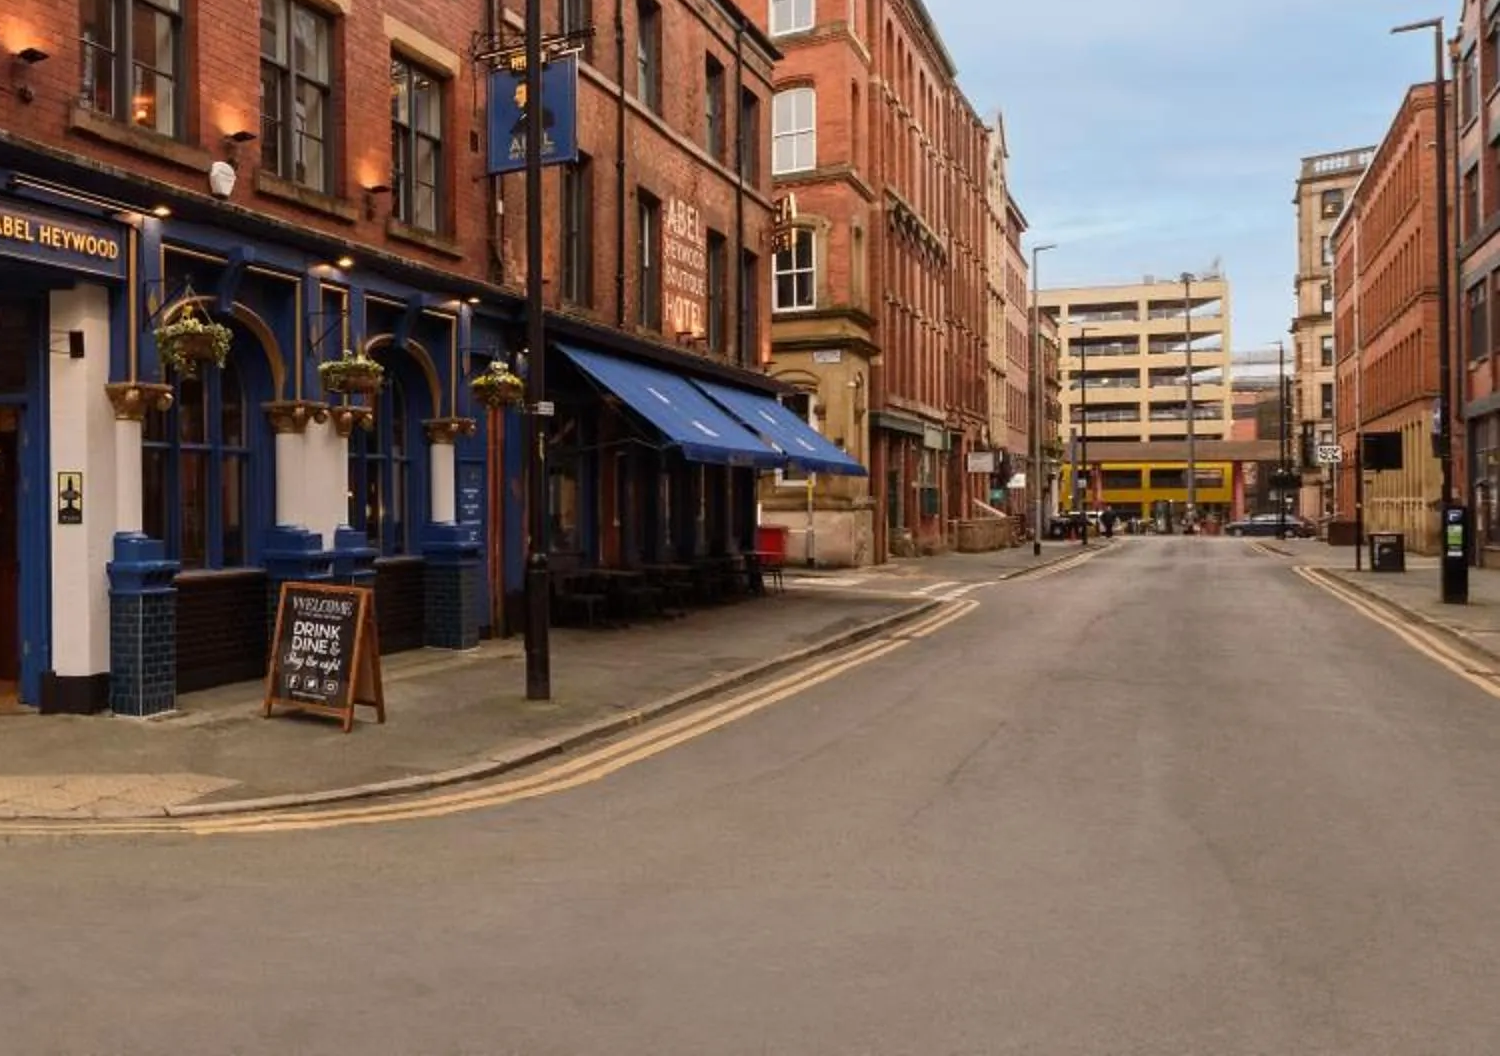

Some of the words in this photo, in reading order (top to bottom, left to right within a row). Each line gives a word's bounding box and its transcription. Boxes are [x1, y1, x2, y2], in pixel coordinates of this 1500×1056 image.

[667, 196, 702, 245] ABEL
[39, 225, 119, 259] HEYWOOD
[293, 621, 341, 640] DRINK
[291, 635, 329, 654] DINE
[329, 642, 341, 656] &
